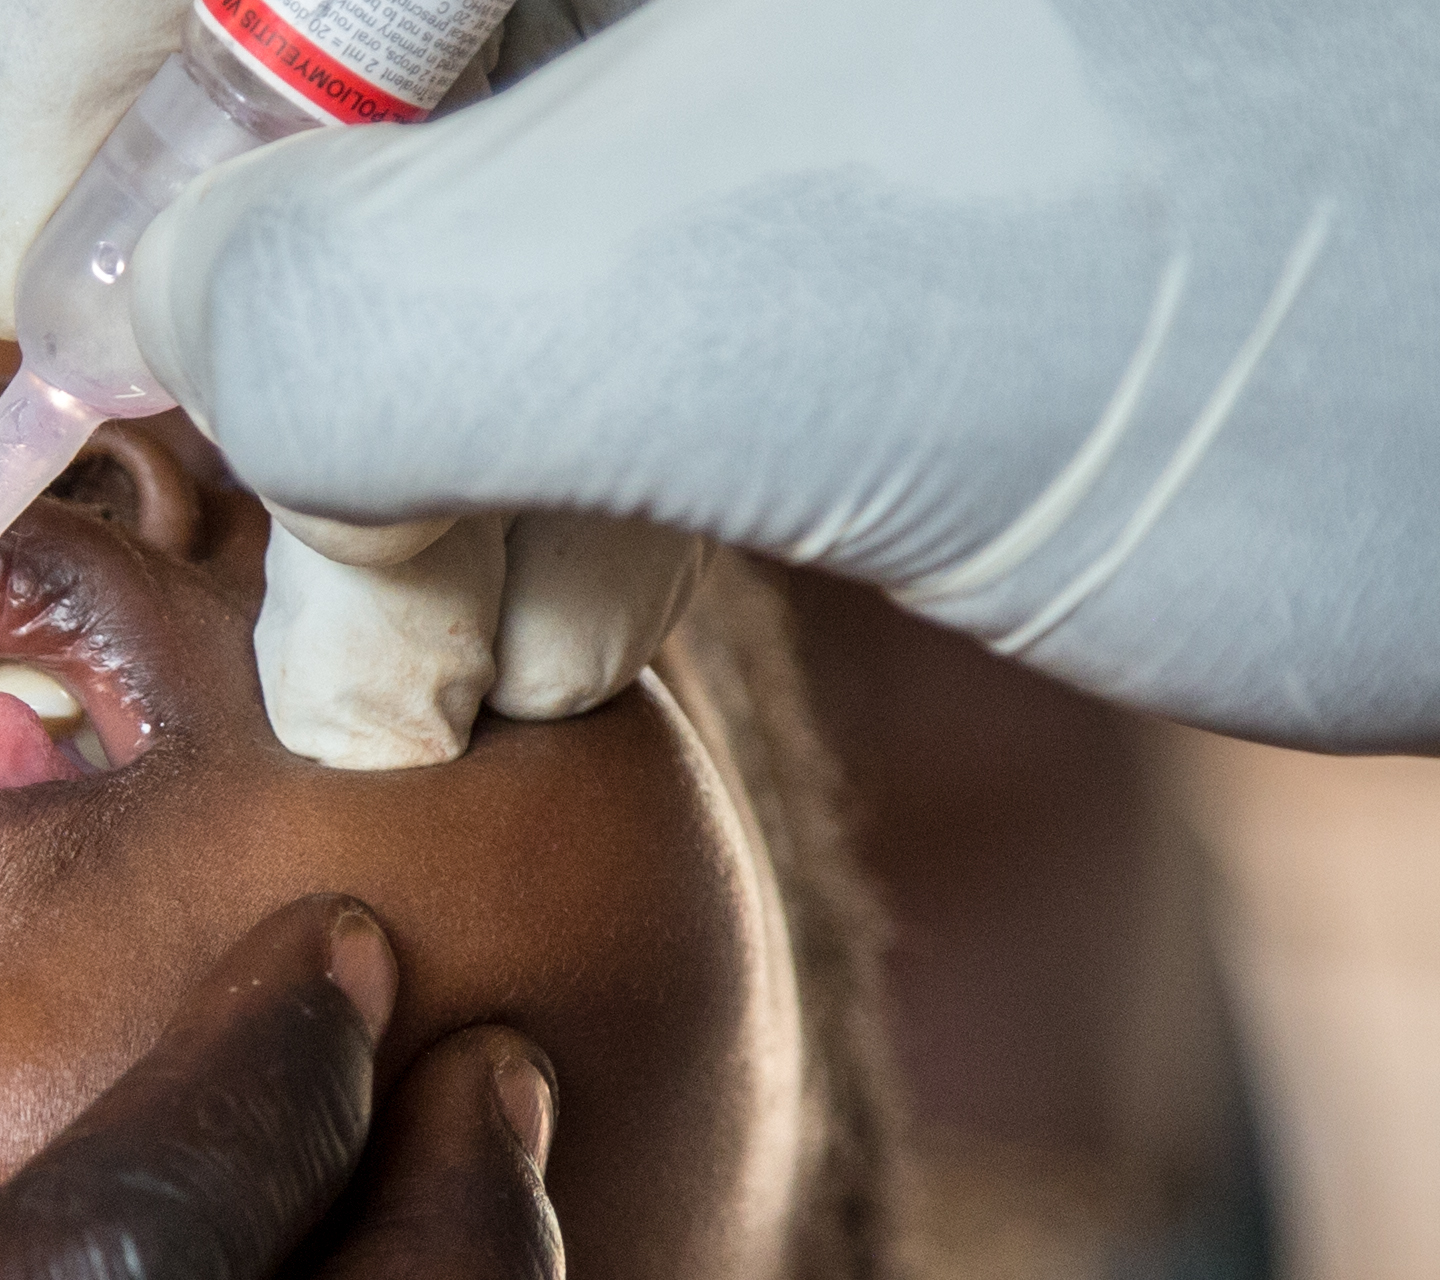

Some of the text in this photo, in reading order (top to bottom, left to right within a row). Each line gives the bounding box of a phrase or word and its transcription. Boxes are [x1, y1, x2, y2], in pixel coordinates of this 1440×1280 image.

[382, 6, 397, 23] to
[436, 0, 450, 14] C
[307, 16, 331, 39] 20
[396, 16, 421, 36] not
[350, 29, 381, 51] oral
[376, 22, 428, 58] primary
[422, 31, 432, 46] is
[341, 43, 366, 62] ml
[385, 46, 421, 75] drops,
[242, 10, 388, 121] POLIOMYELITIS
[364, 58, 379, 73] 2
[379, 67, 429, 102] Trivalent
